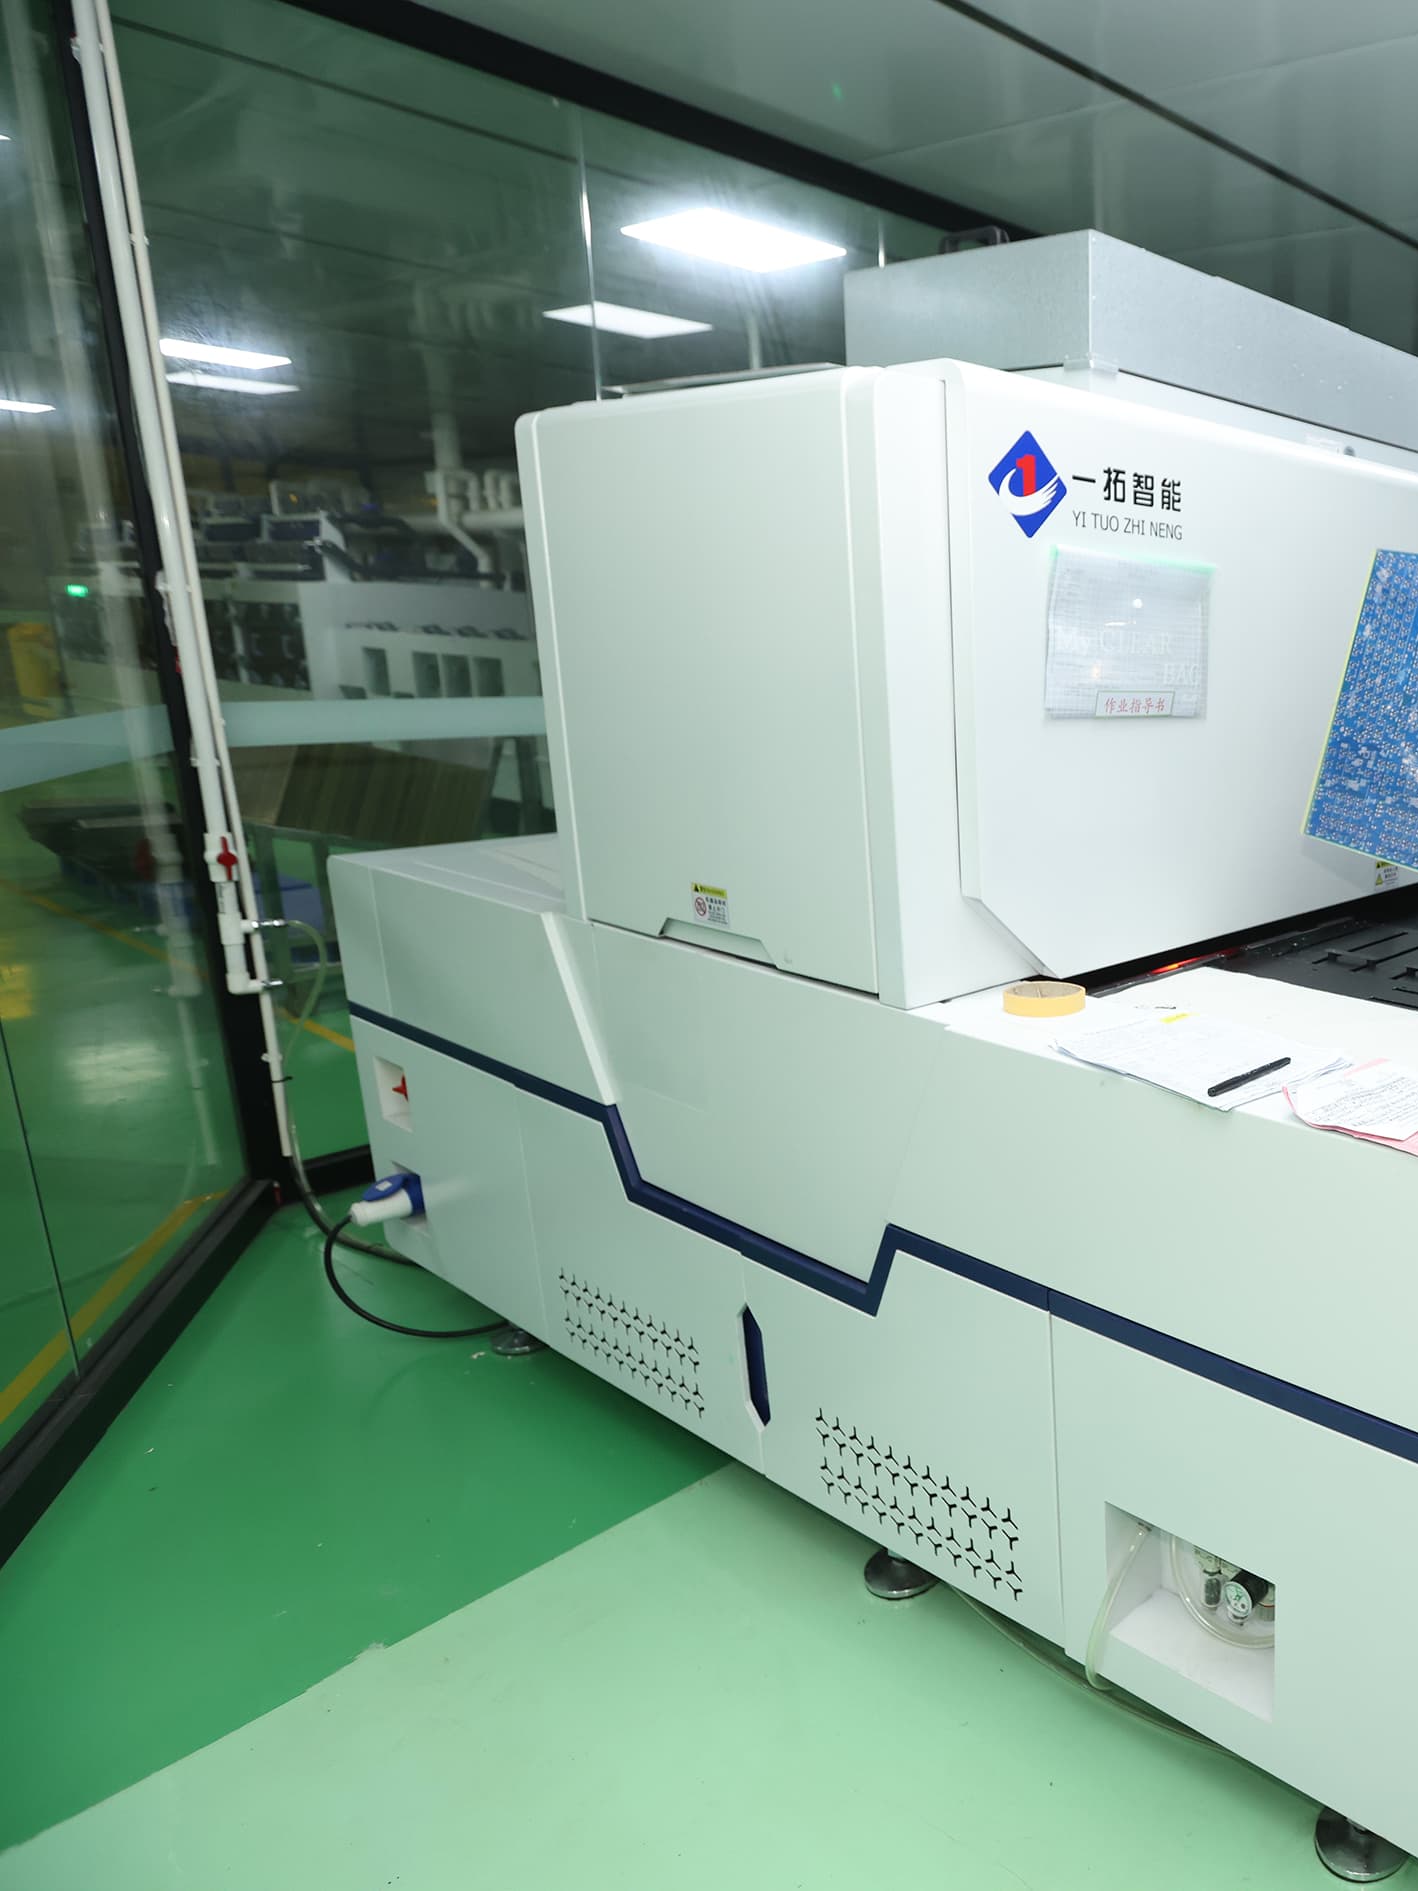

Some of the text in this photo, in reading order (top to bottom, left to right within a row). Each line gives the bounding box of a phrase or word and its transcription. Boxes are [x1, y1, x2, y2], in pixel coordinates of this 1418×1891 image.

[1072, 467, 1182, 512] 一拓智能
[1072, 510, 1183, 541] YI TUO ZHI NENG
[1105, 697, 1166, 714] 作业指导书
